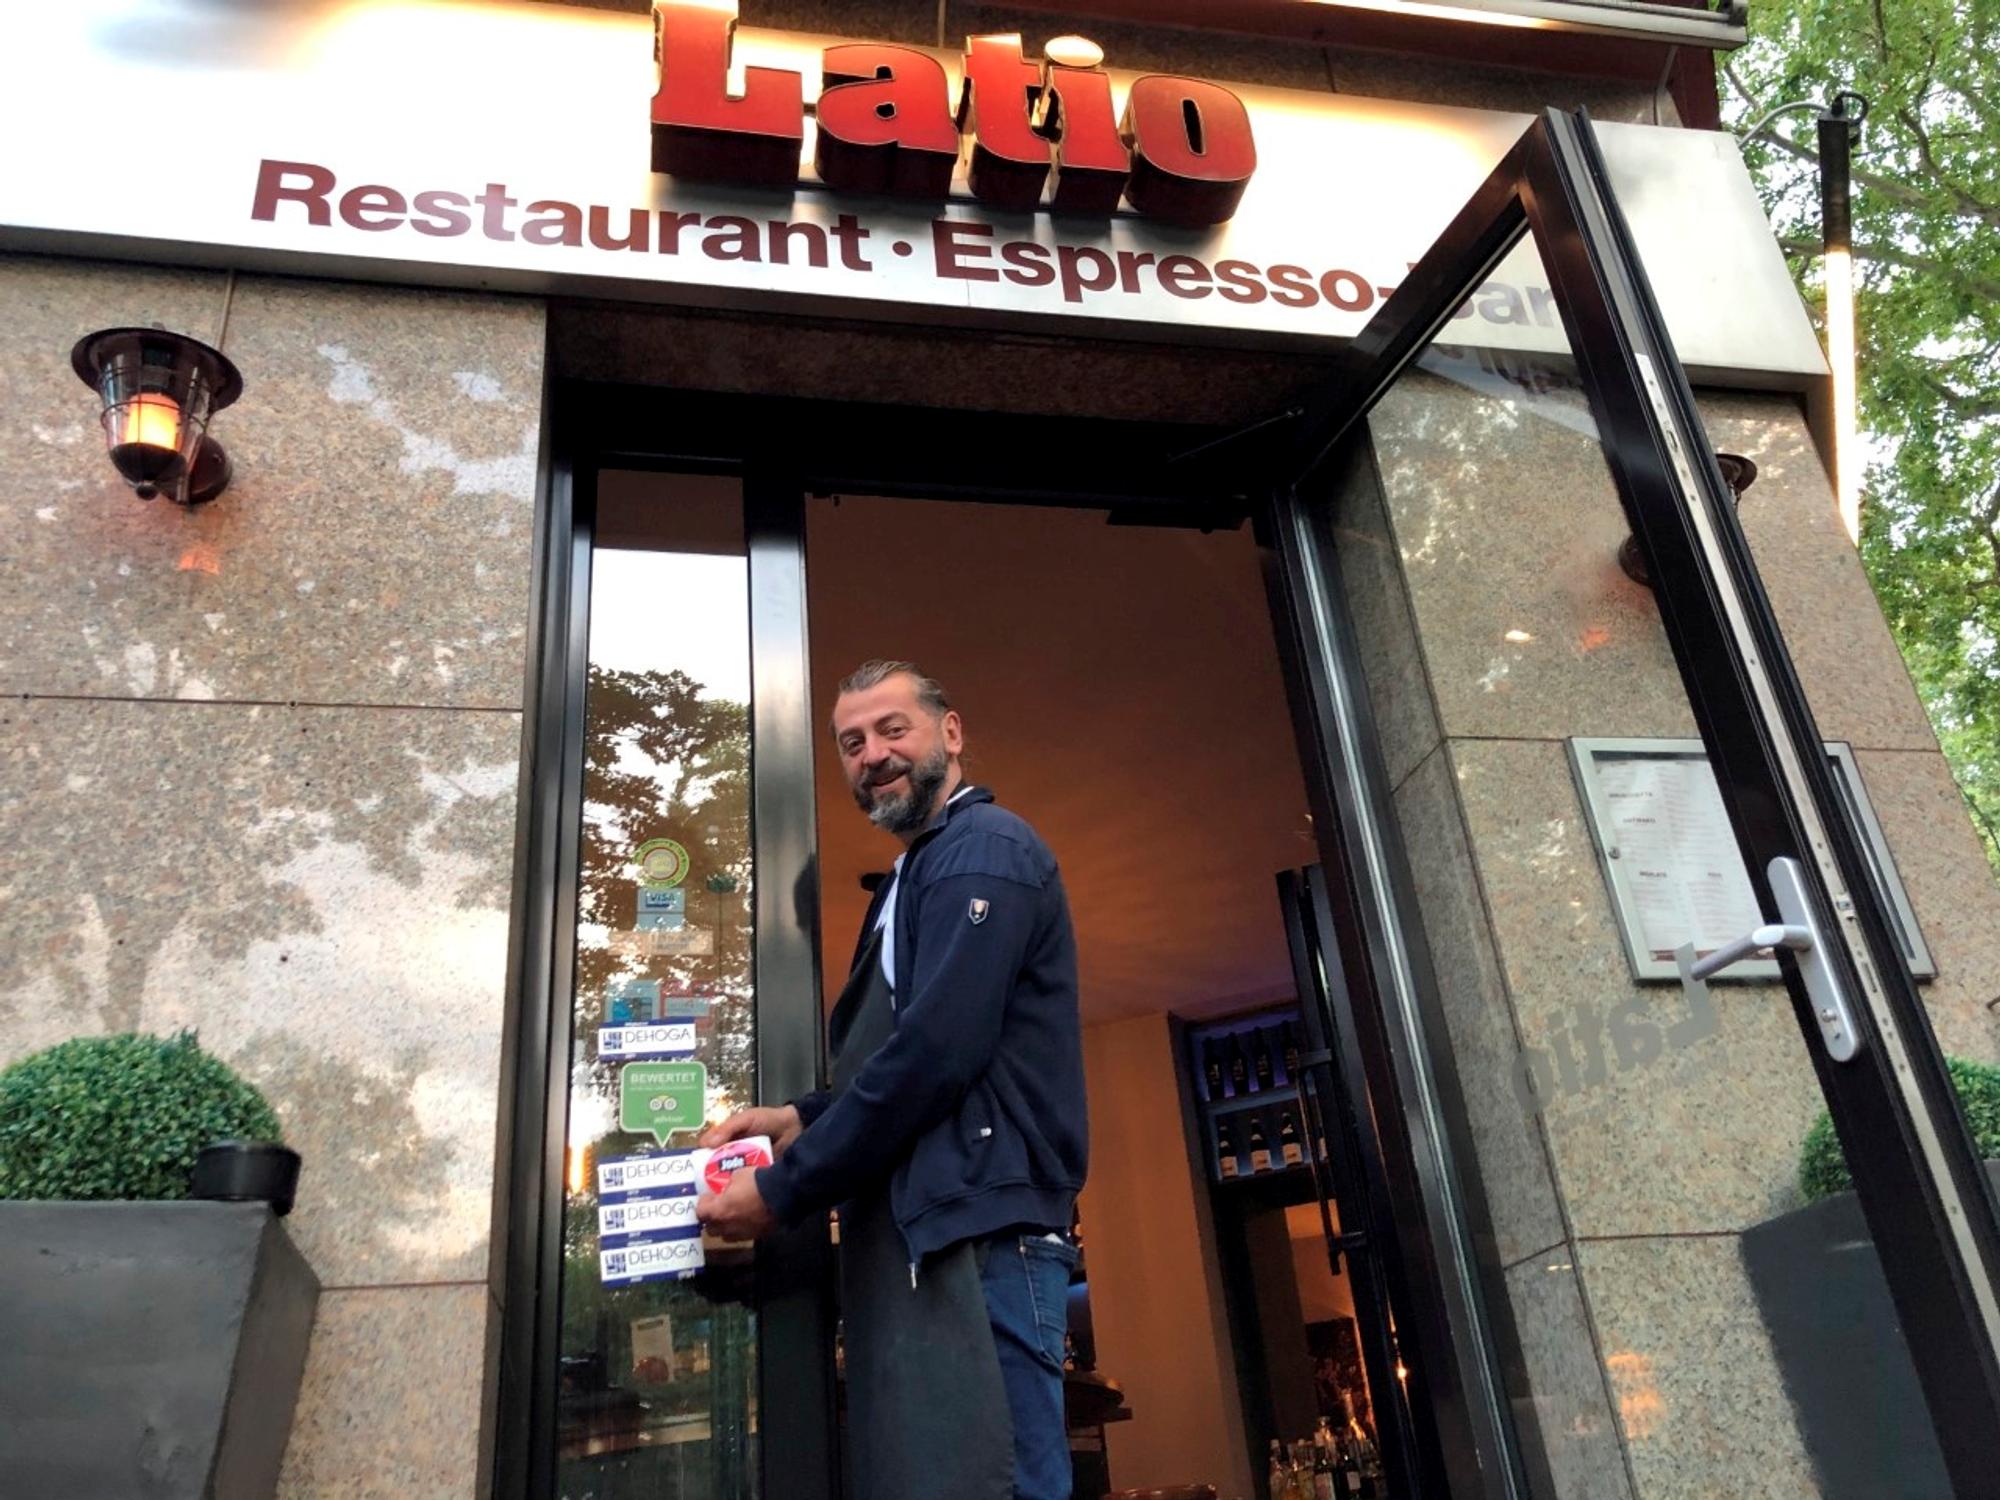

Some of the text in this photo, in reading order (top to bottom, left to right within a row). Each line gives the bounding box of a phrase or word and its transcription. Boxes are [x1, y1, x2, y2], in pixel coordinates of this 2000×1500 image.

[651, 0, 1256, 183] Latio
[250, 158, 873, 272] Restaurant
[630, 1072, 697, 1084] BEWERTET
